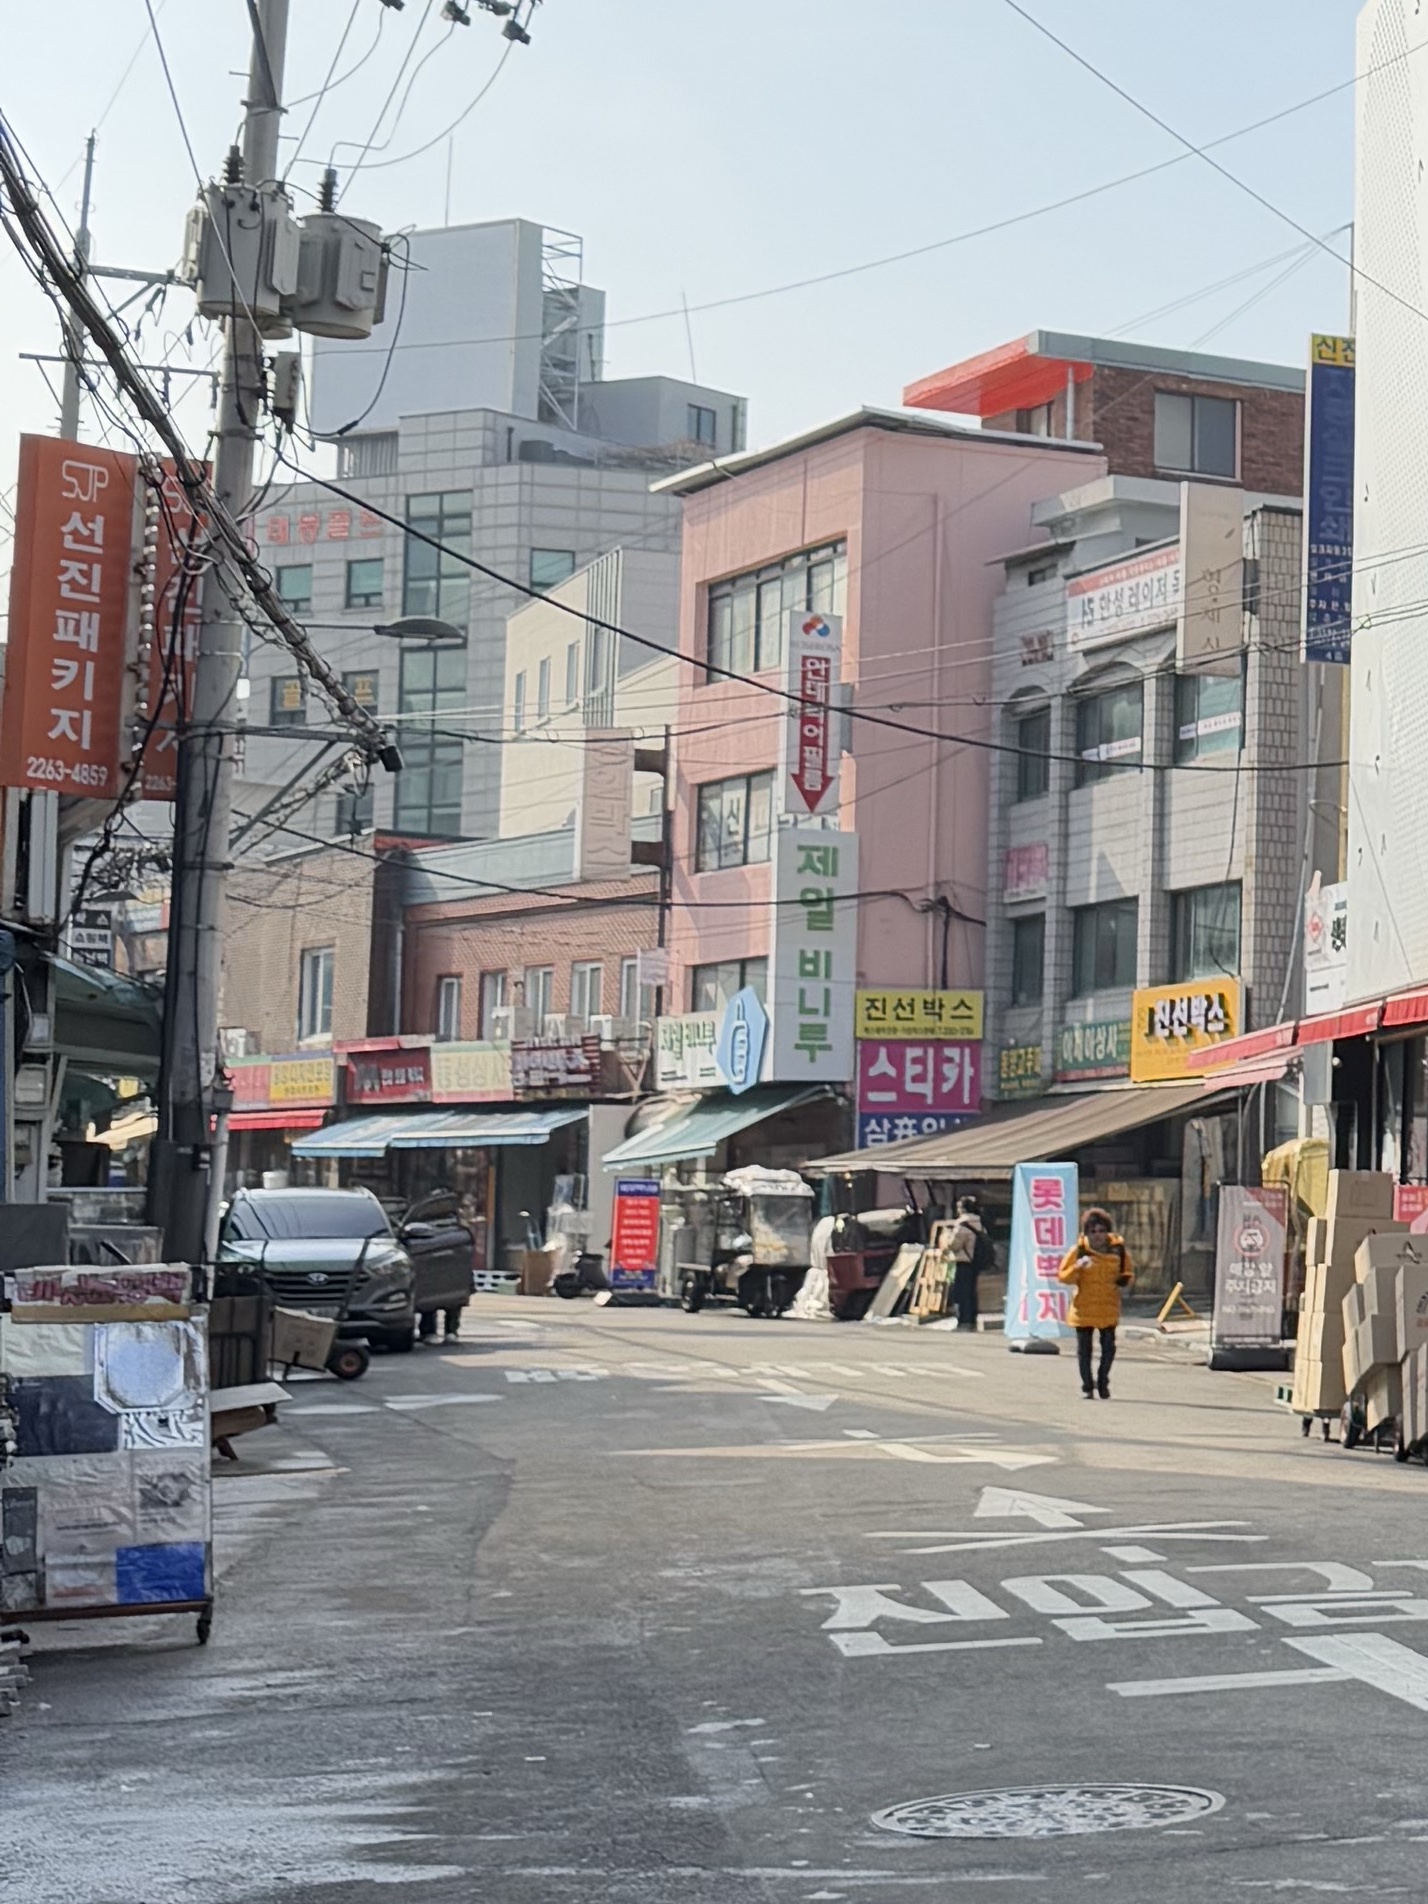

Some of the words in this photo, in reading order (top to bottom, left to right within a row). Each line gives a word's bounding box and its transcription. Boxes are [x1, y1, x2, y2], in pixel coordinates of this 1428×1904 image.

[47, 510, 105, 752] 선진패키지
[25, 755, 108, 788] 2263-4859
[865, 997, 975, 1022] 진선박스
[867, 1046, 975, 1105] 스티카
